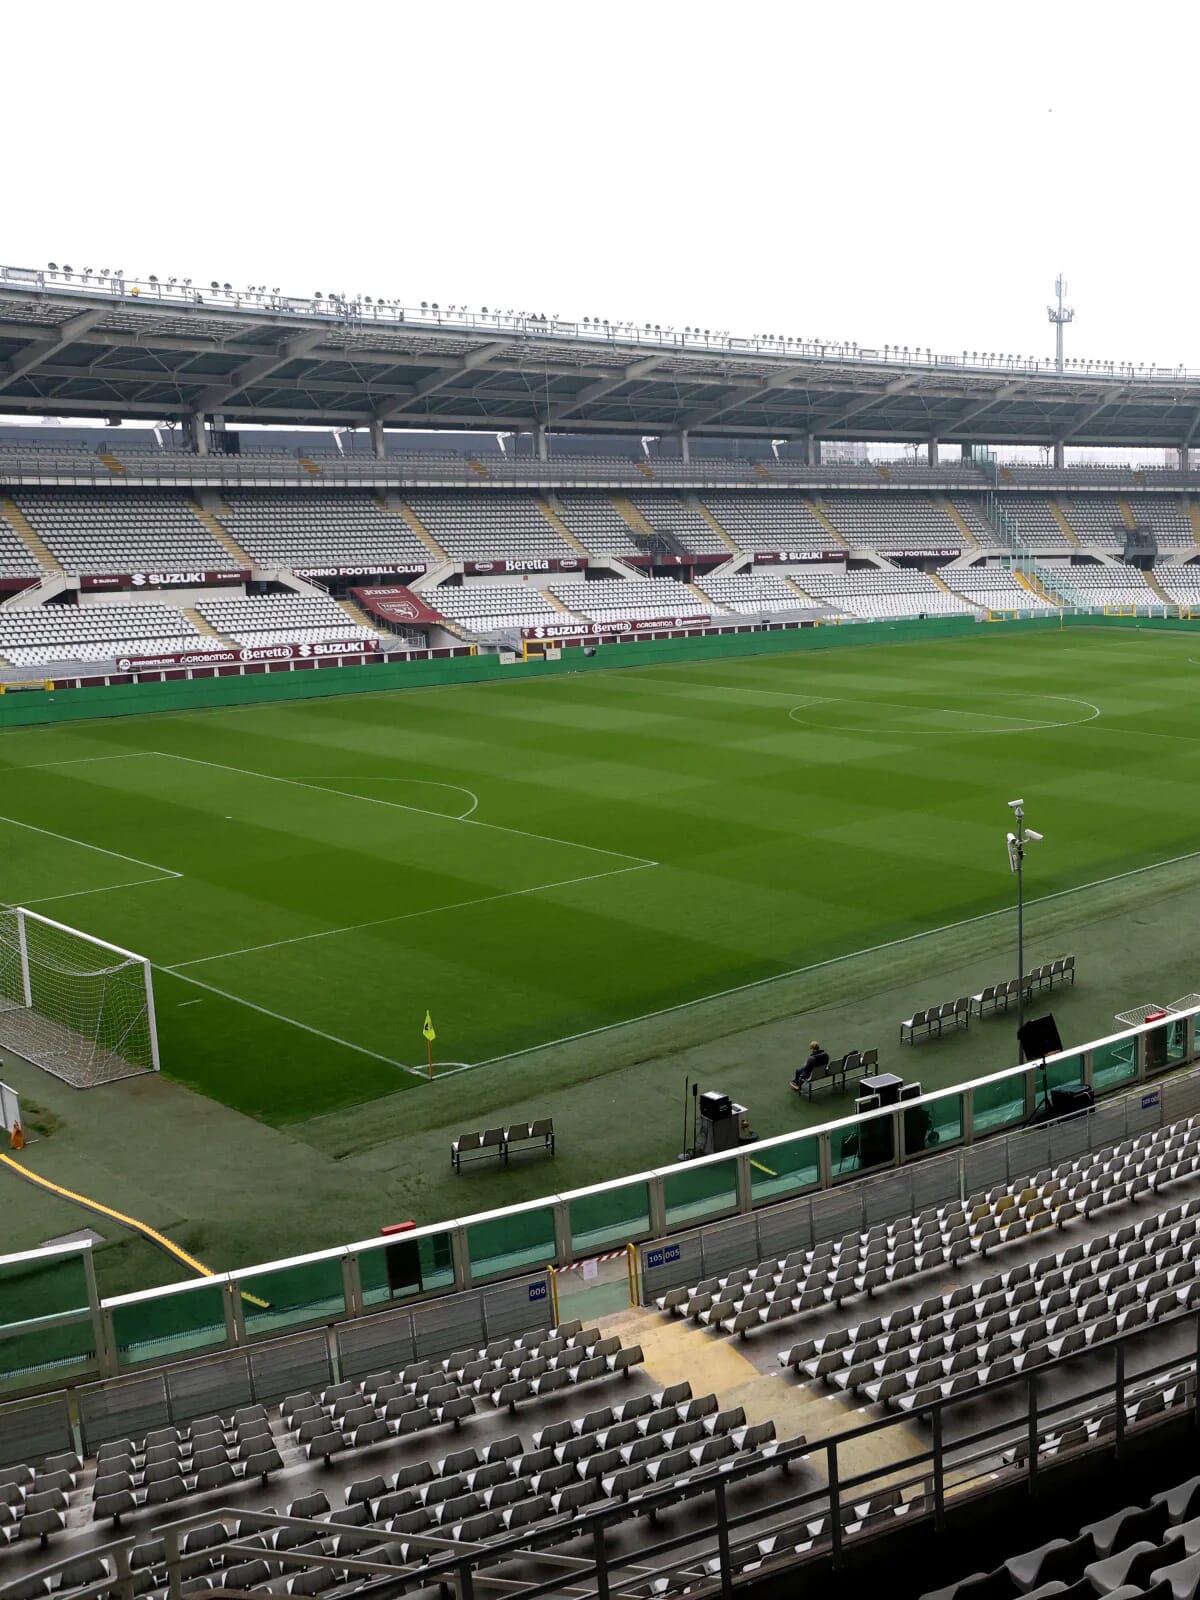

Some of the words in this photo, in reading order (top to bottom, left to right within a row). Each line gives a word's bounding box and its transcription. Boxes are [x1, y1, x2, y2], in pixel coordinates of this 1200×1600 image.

[789, 552, 823, 560] SUZUKI
[294, 569, 337, 577] TORINO
[339, 566, 396, 576] FOOTBALL
[397, 564, 425, 573] CLUB
[505, 559, 549, 571] Beretta
[149, 572, 206, 585] SUZUKI
[547, 625, 588, 637] SUZUKI
[594, 622, 630, 633] Beretta
[244, 647, 290, 660] Beretta
[314, 641, 364, 654] SUZUKI
[649, 1254, 663, 1264] 105
[665, 1249, 680, 1260] 005
[529, 1286, 546, 1298] 006
